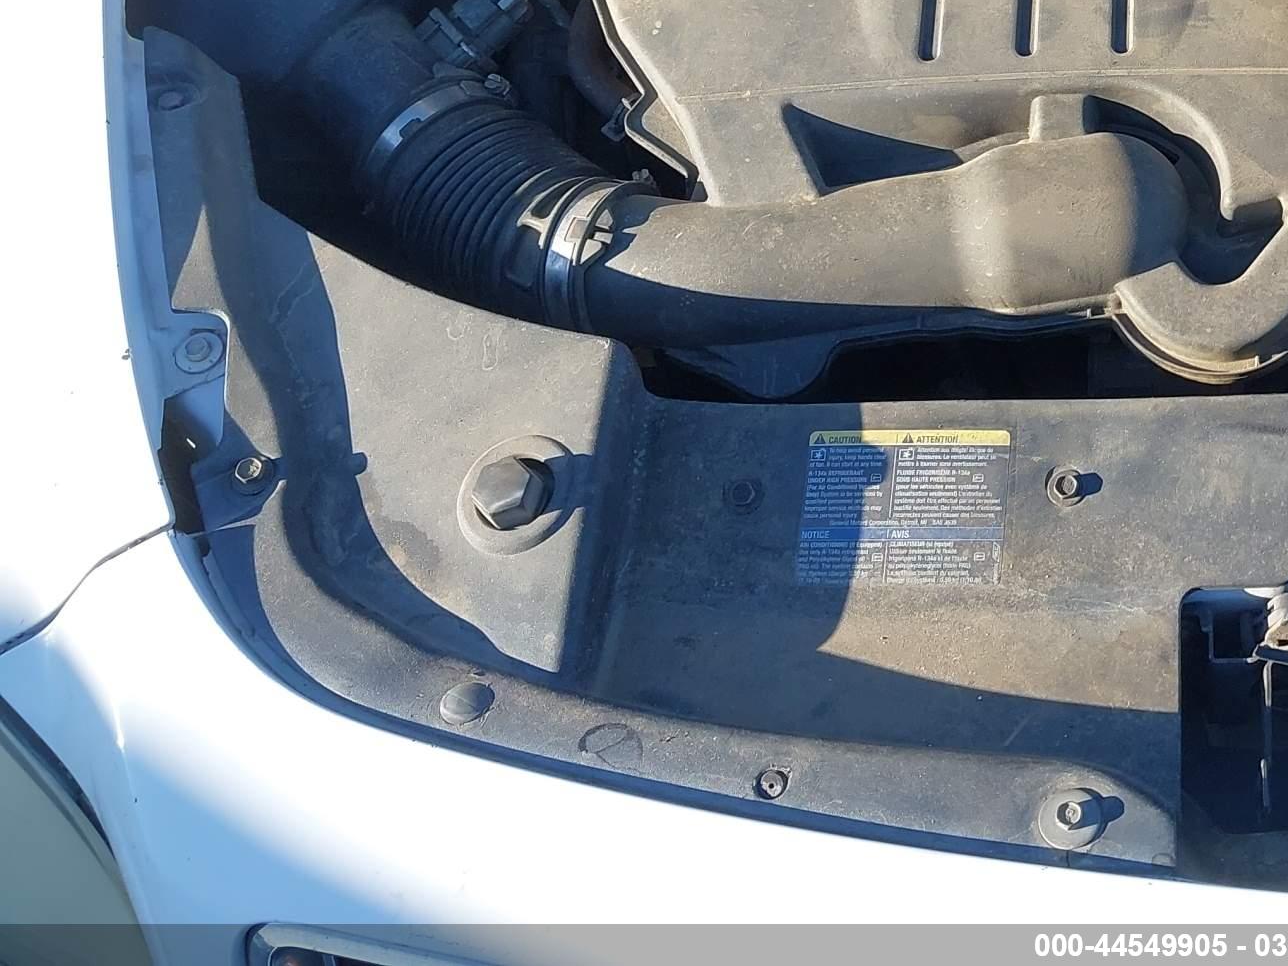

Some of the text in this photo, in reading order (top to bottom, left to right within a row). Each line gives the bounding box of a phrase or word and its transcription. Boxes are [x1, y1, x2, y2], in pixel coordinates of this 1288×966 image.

[829, 436, 862, 444] CAUTION
[916, 436, 959, 444] ATTENTION
[802, 531, 831, 539] NOTICE
[891, 530, 910, 539] AVIS
